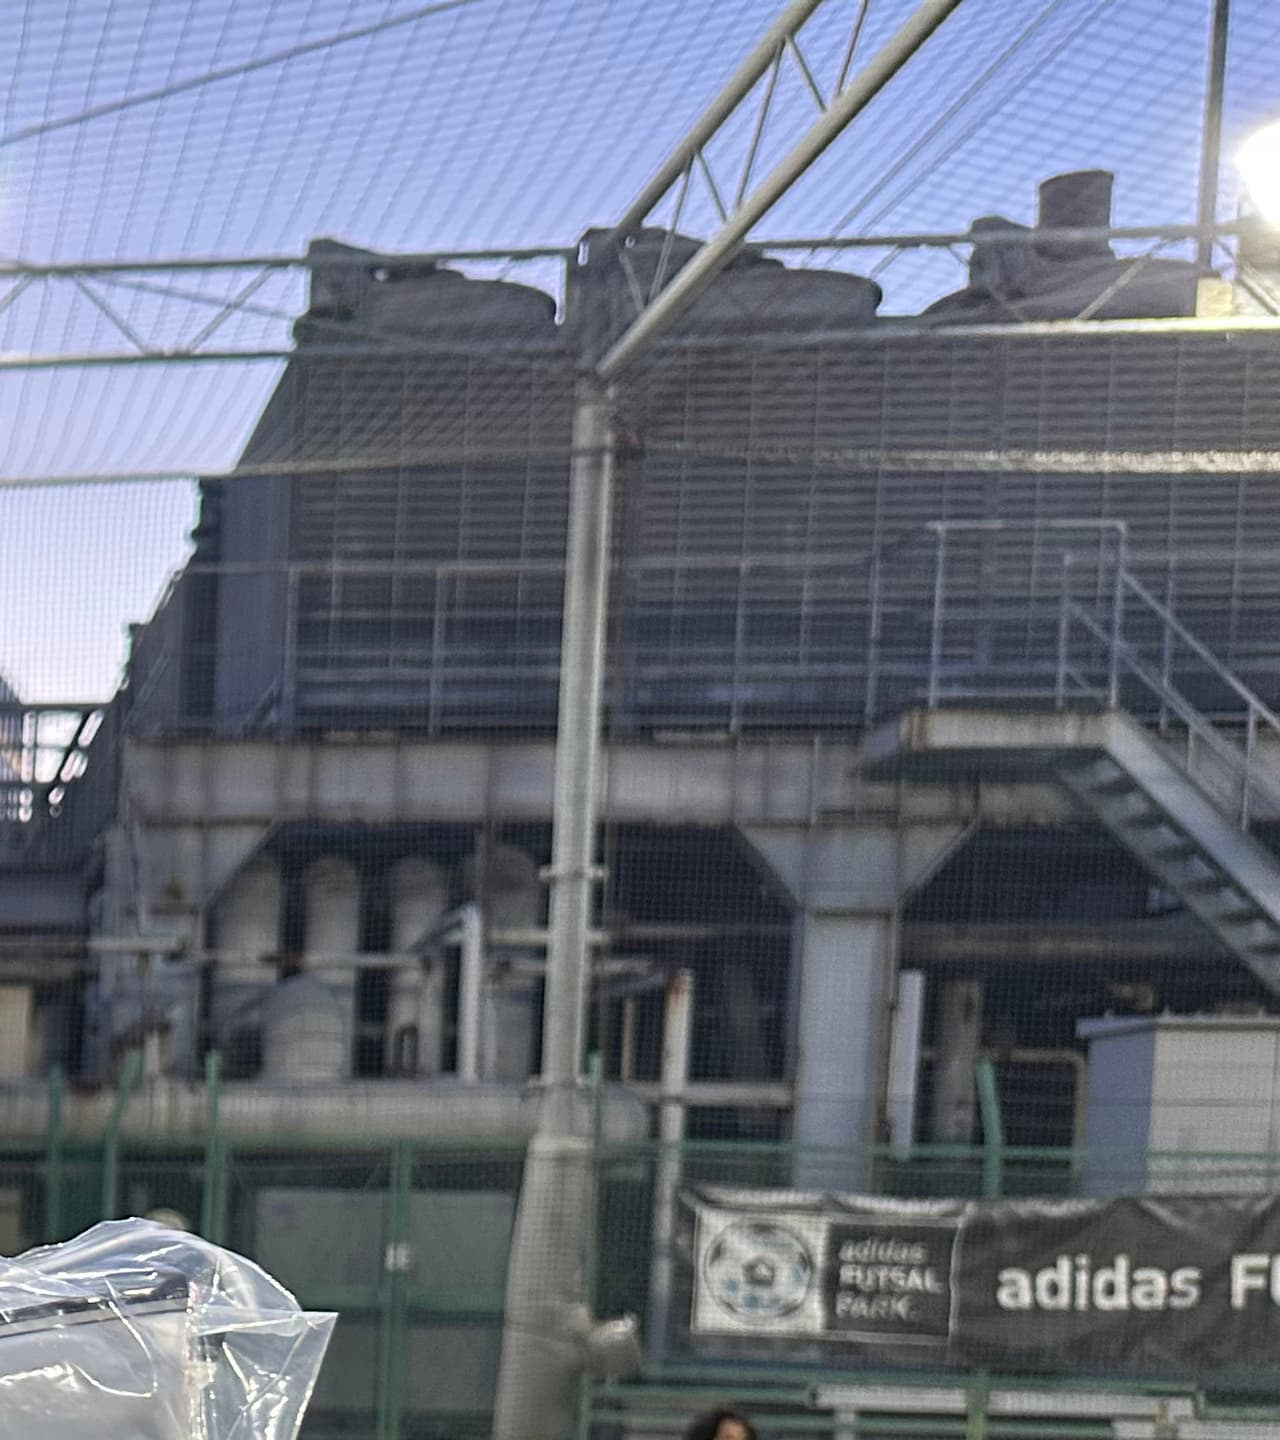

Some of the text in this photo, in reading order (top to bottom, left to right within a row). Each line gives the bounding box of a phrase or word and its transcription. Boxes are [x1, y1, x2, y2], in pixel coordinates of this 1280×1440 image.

[839, 1265, 944, 1293] FUTSAL
[996, 1253, 1280, 1310] adidas F
[836, 1292, 910, 1320] PARK
